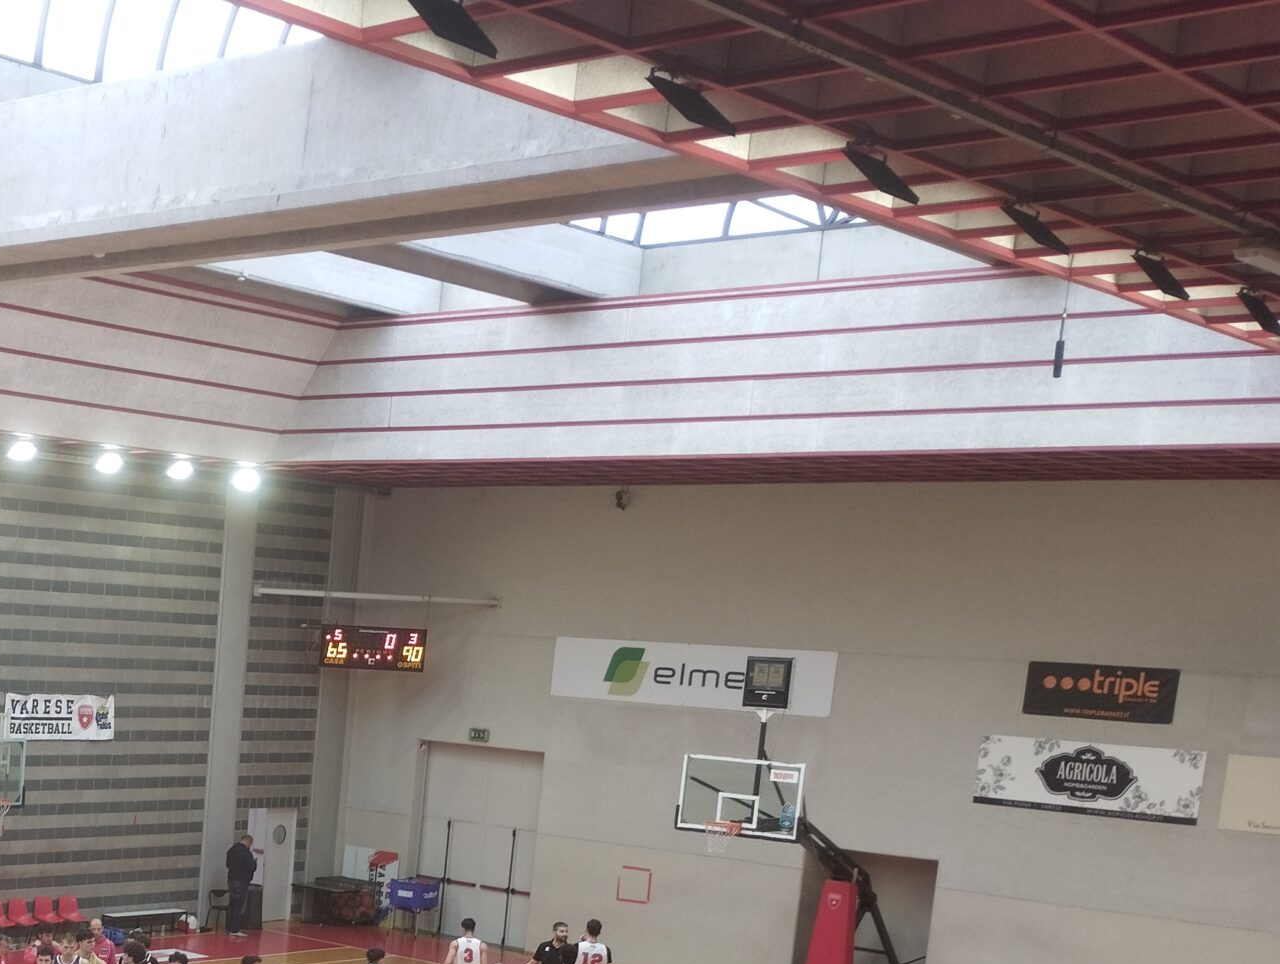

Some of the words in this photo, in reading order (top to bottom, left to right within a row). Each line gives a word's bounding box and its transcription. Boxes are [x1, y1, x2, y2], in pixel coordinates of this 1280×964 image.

[384, 633, 397, 649] 0
[408, 633, 418, 645] 3
[402, 646, 423, 662] 90
[653, 663, 746, 690] elme
[1092, 669, 1160, 703] triple
[10, 699, 74, 715] VARESE
[9, 722, 72, 735] BASKETBALL
[1056, 760, 1117, 784] AGRICOLA
[464, 947, 474, 964] 3
